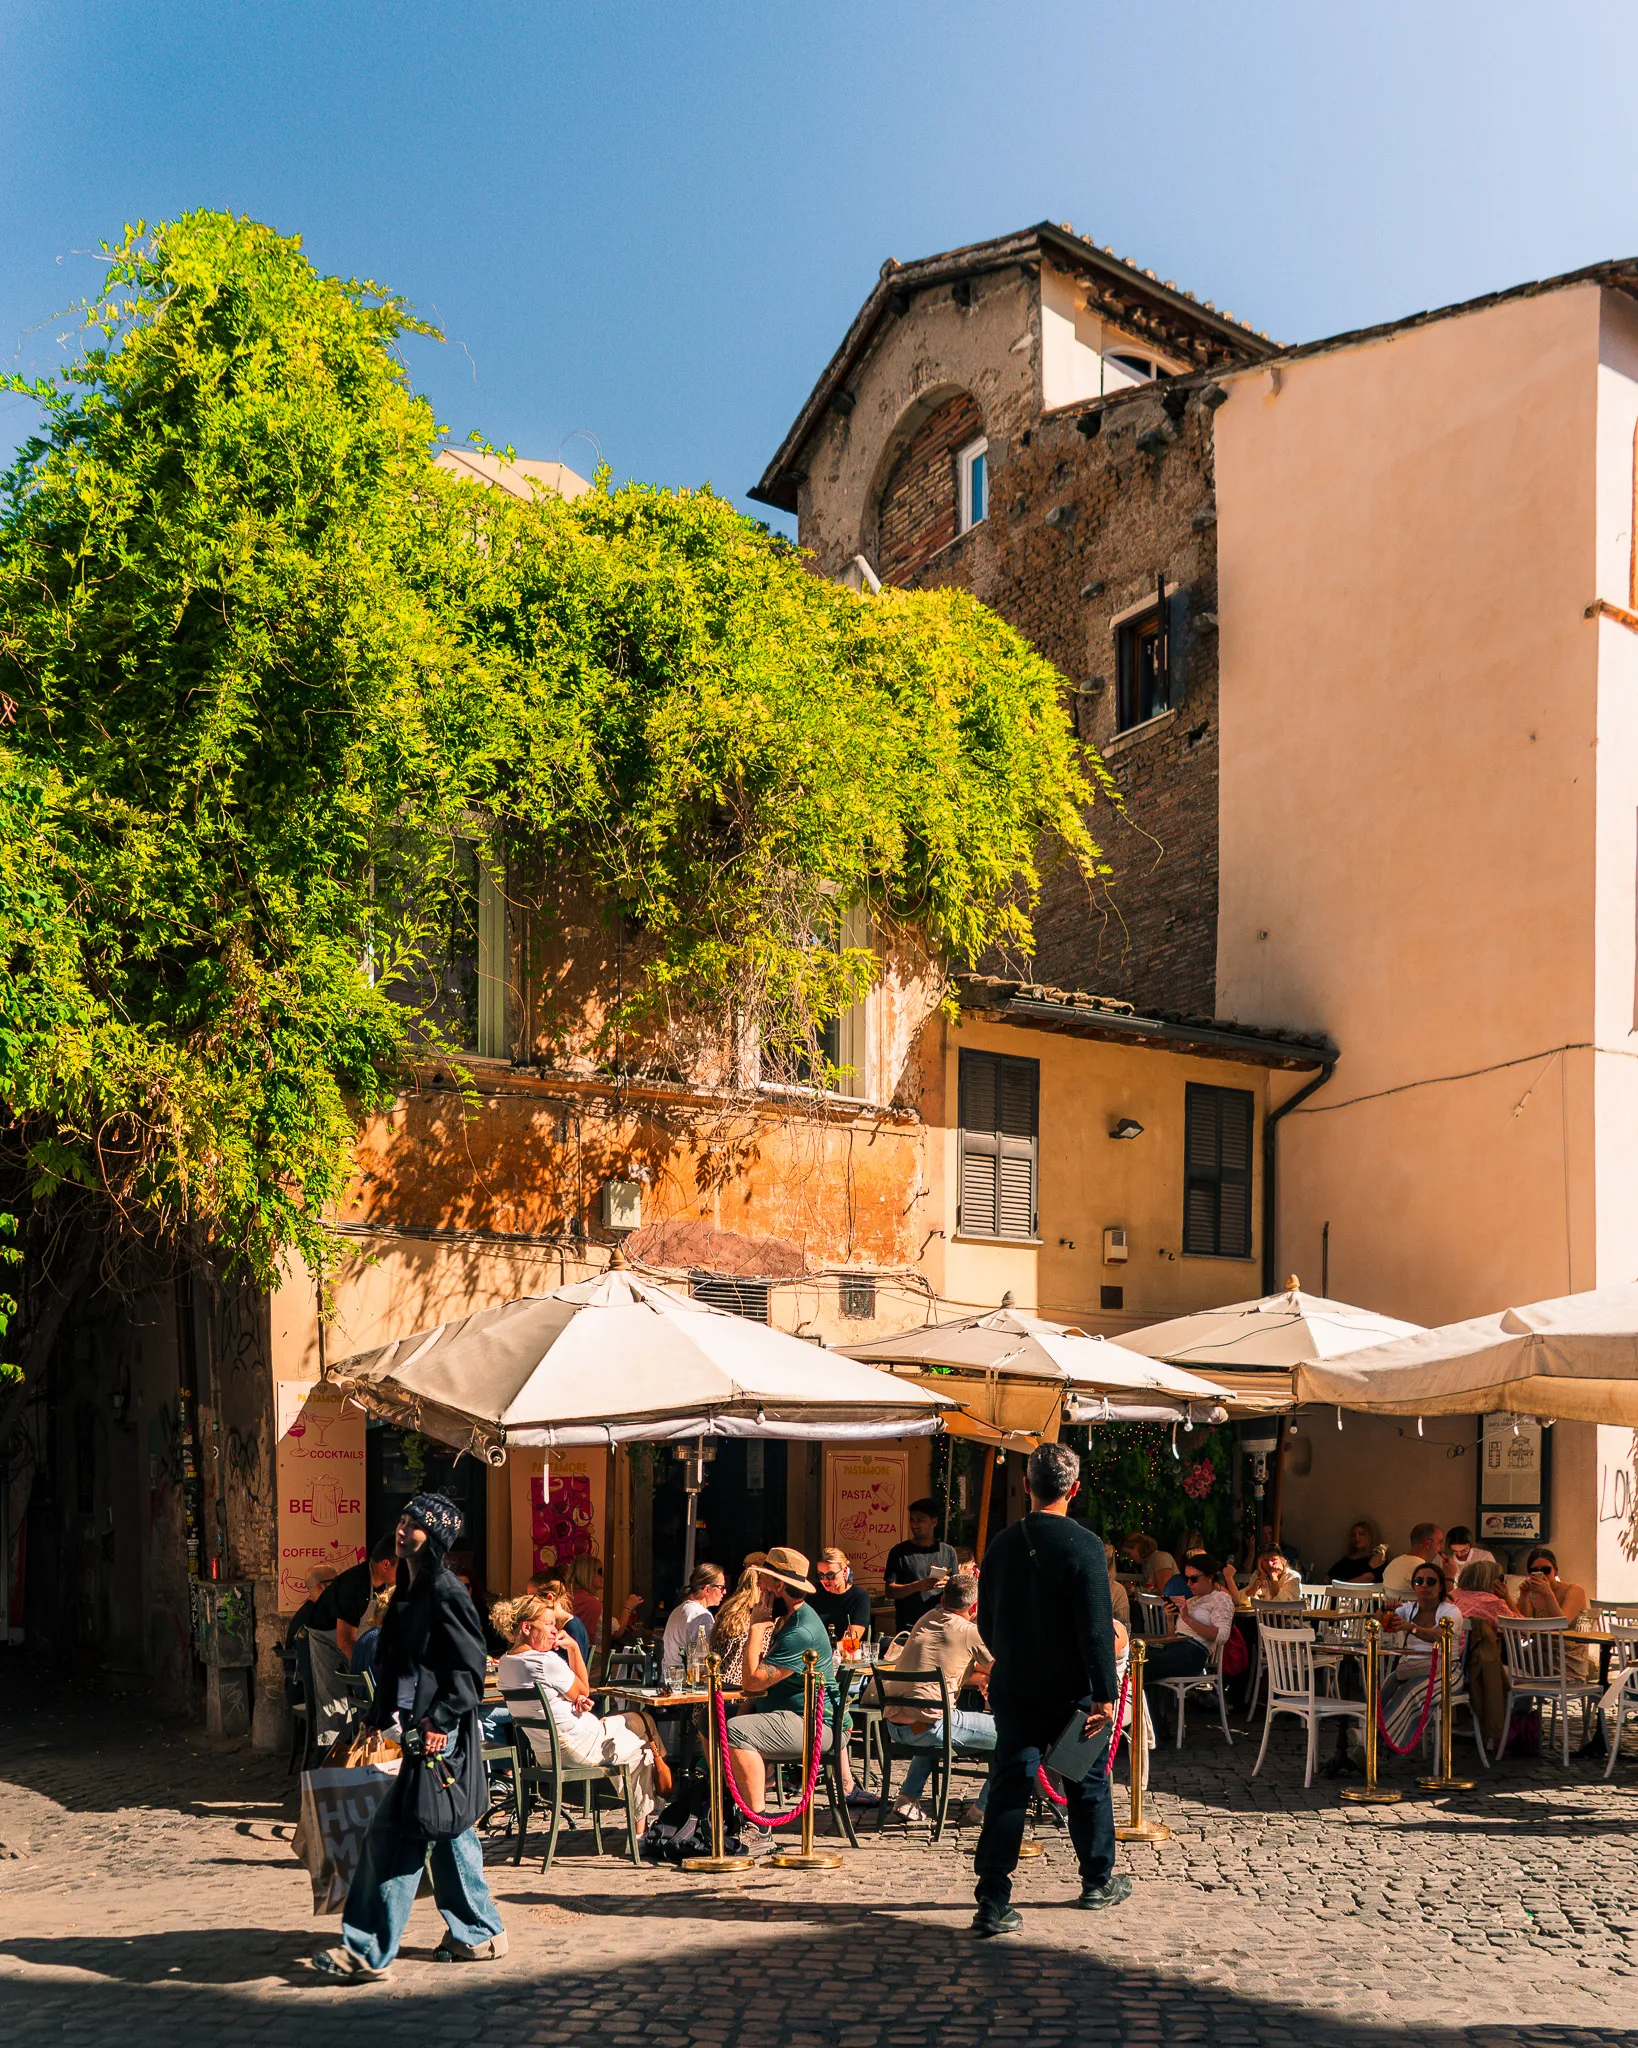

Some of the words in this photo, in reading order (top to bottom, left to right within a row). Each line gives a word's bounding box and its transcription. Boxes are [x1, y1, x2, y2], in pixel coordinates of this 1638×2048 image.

[297, 1393, 343, 1403] PASTAMOR
[310, 1450, 364, 1459] COCKTAILS
[532, 1462, 587, 1472] PATAMORE
[843, 1465, 890, 1476] PASTAMORE
[841, 1490, 872, 1500] PASTA
[868, 1524, 896, 1533] PIZZA
[1503, 1522, 1534, 1530] ROMA
[282, 1547, 326, 1558] COFFEE
[844, 1552, 868, 1560] ANINO
